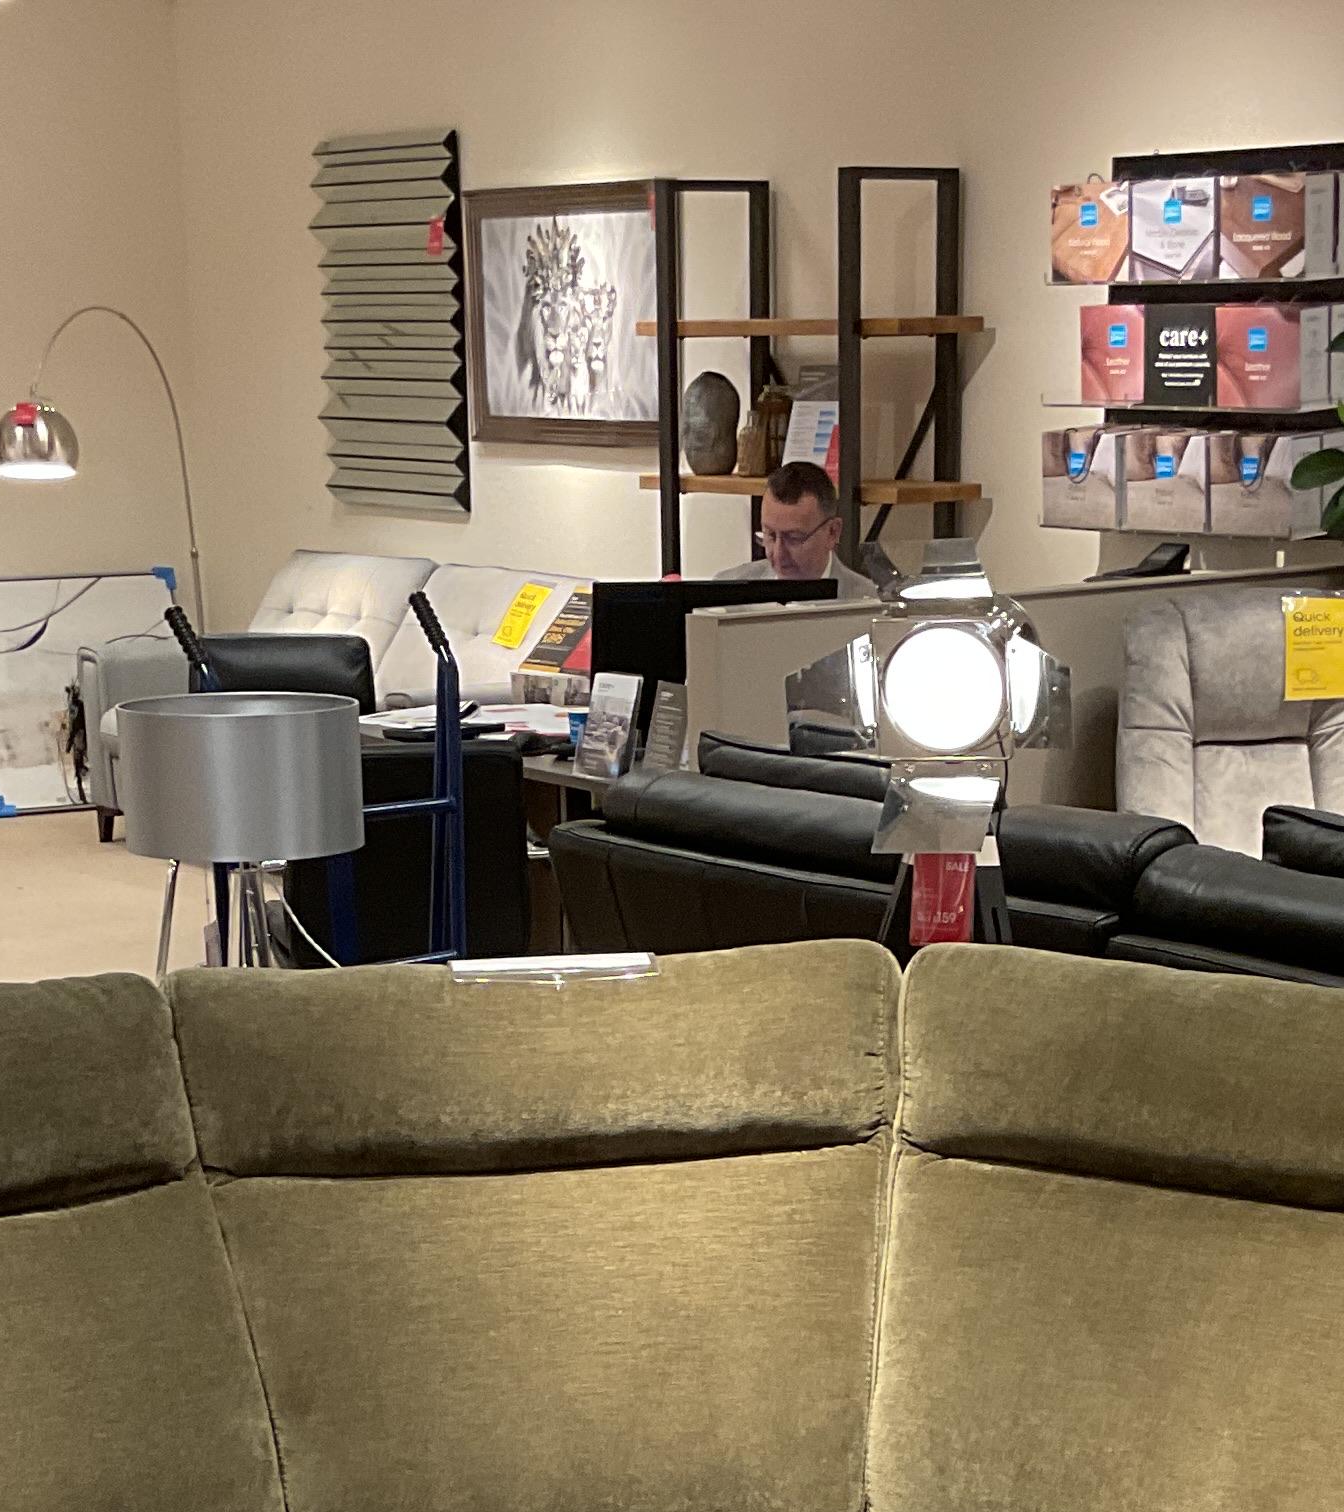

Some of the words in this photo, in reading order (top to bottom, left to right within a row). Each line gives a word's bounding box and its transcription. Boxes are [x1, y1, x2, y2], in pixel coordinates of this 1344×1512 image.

[1159, 329, 1209, 347] care+
[1293, 612, 1331, 622] Quick
[1293, 625, 1344, 637] delivery
